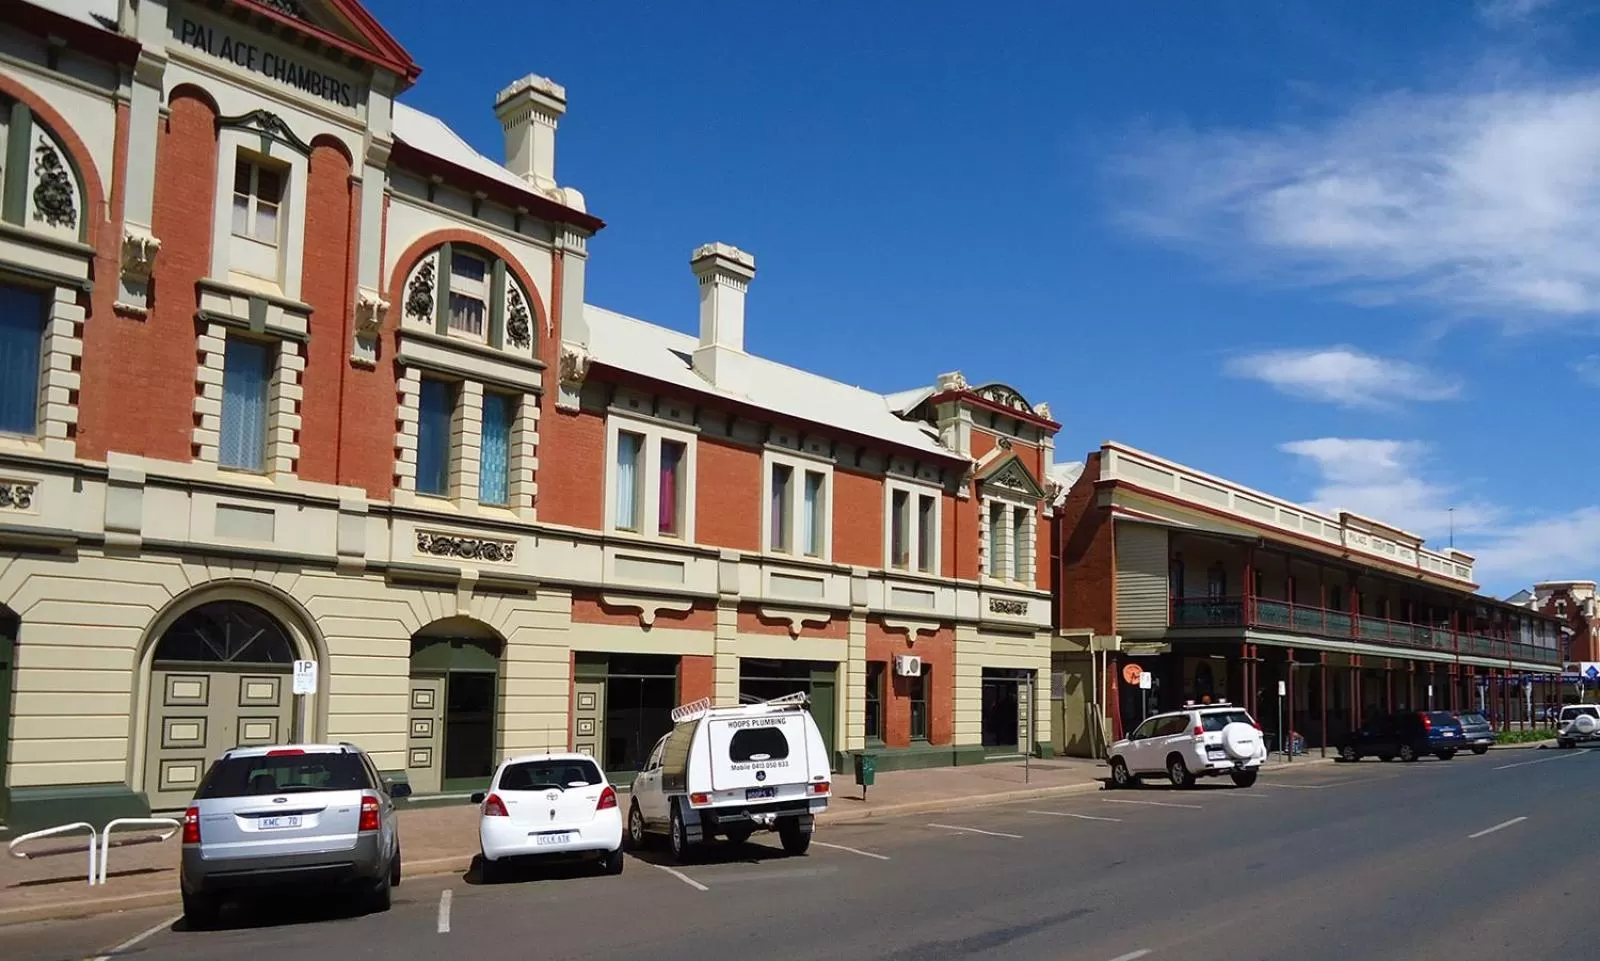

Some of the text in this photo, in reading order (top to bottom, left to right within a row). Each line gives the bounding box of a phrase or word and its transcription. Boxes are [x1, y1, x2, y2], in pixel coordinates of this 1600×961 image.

[181, 18, 350, 107] PALACE CHAMBERS
[299, 661, 313, 672] 1P
[728, 718, 786, 728] HOOPS PLUMBING
